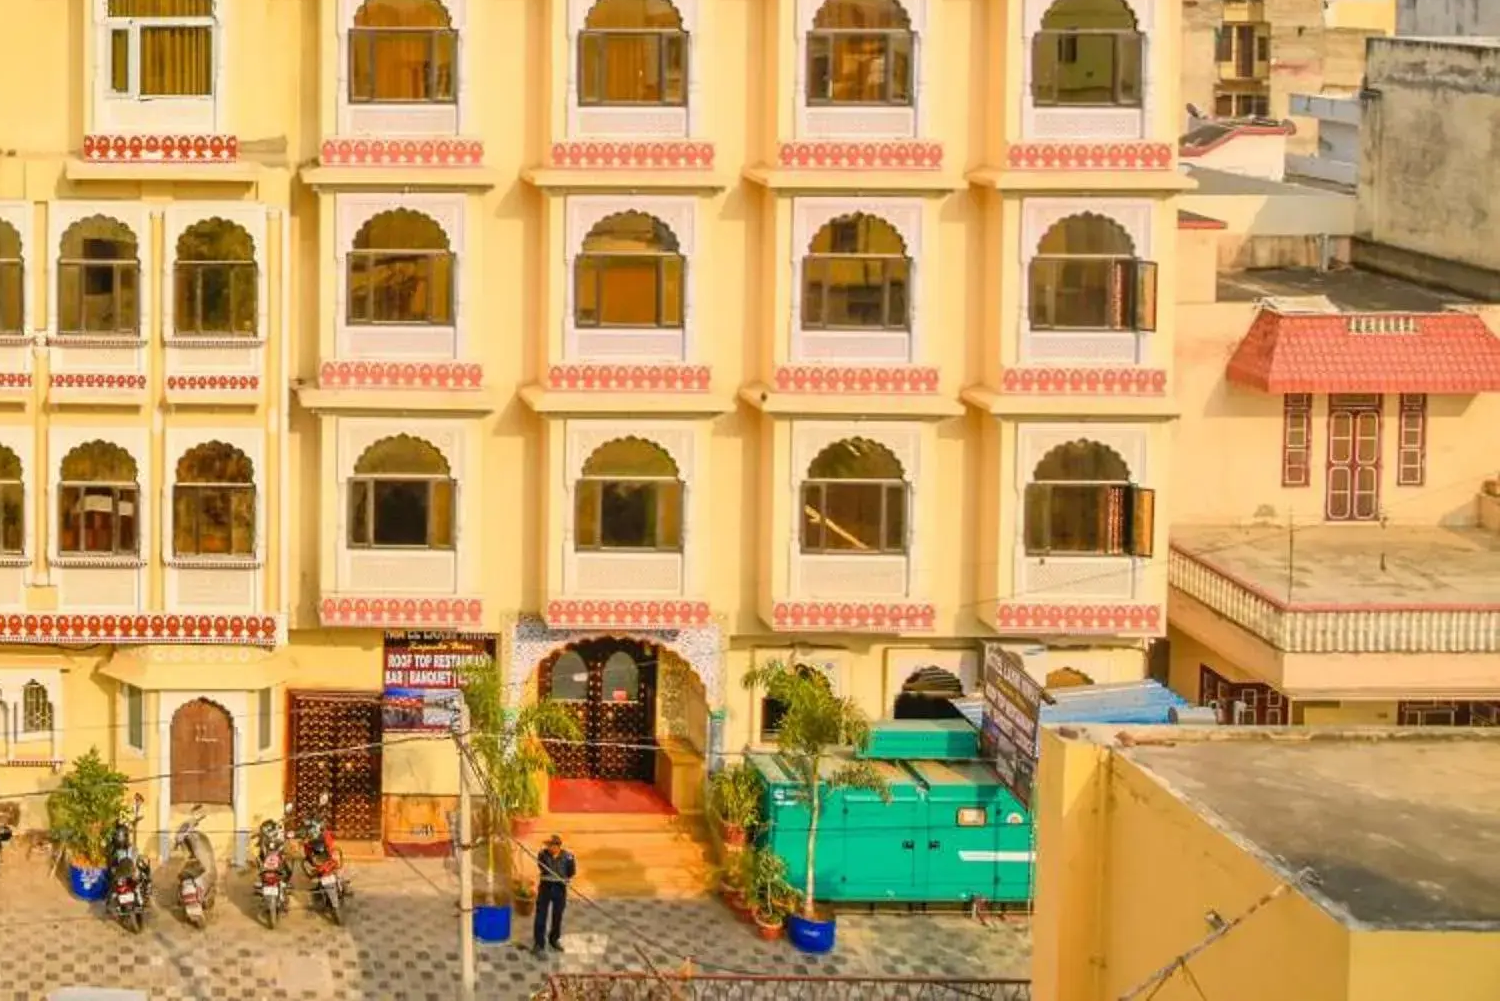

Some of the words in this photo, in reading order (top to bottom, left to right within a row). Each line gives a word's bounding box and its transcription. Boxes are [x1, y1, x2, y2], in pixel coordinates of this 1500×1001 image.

[414, 653, 432, 668] TOP
[433, 653, 493, 669] RESTAU
[409, 669, 451, 685] BANQUET
